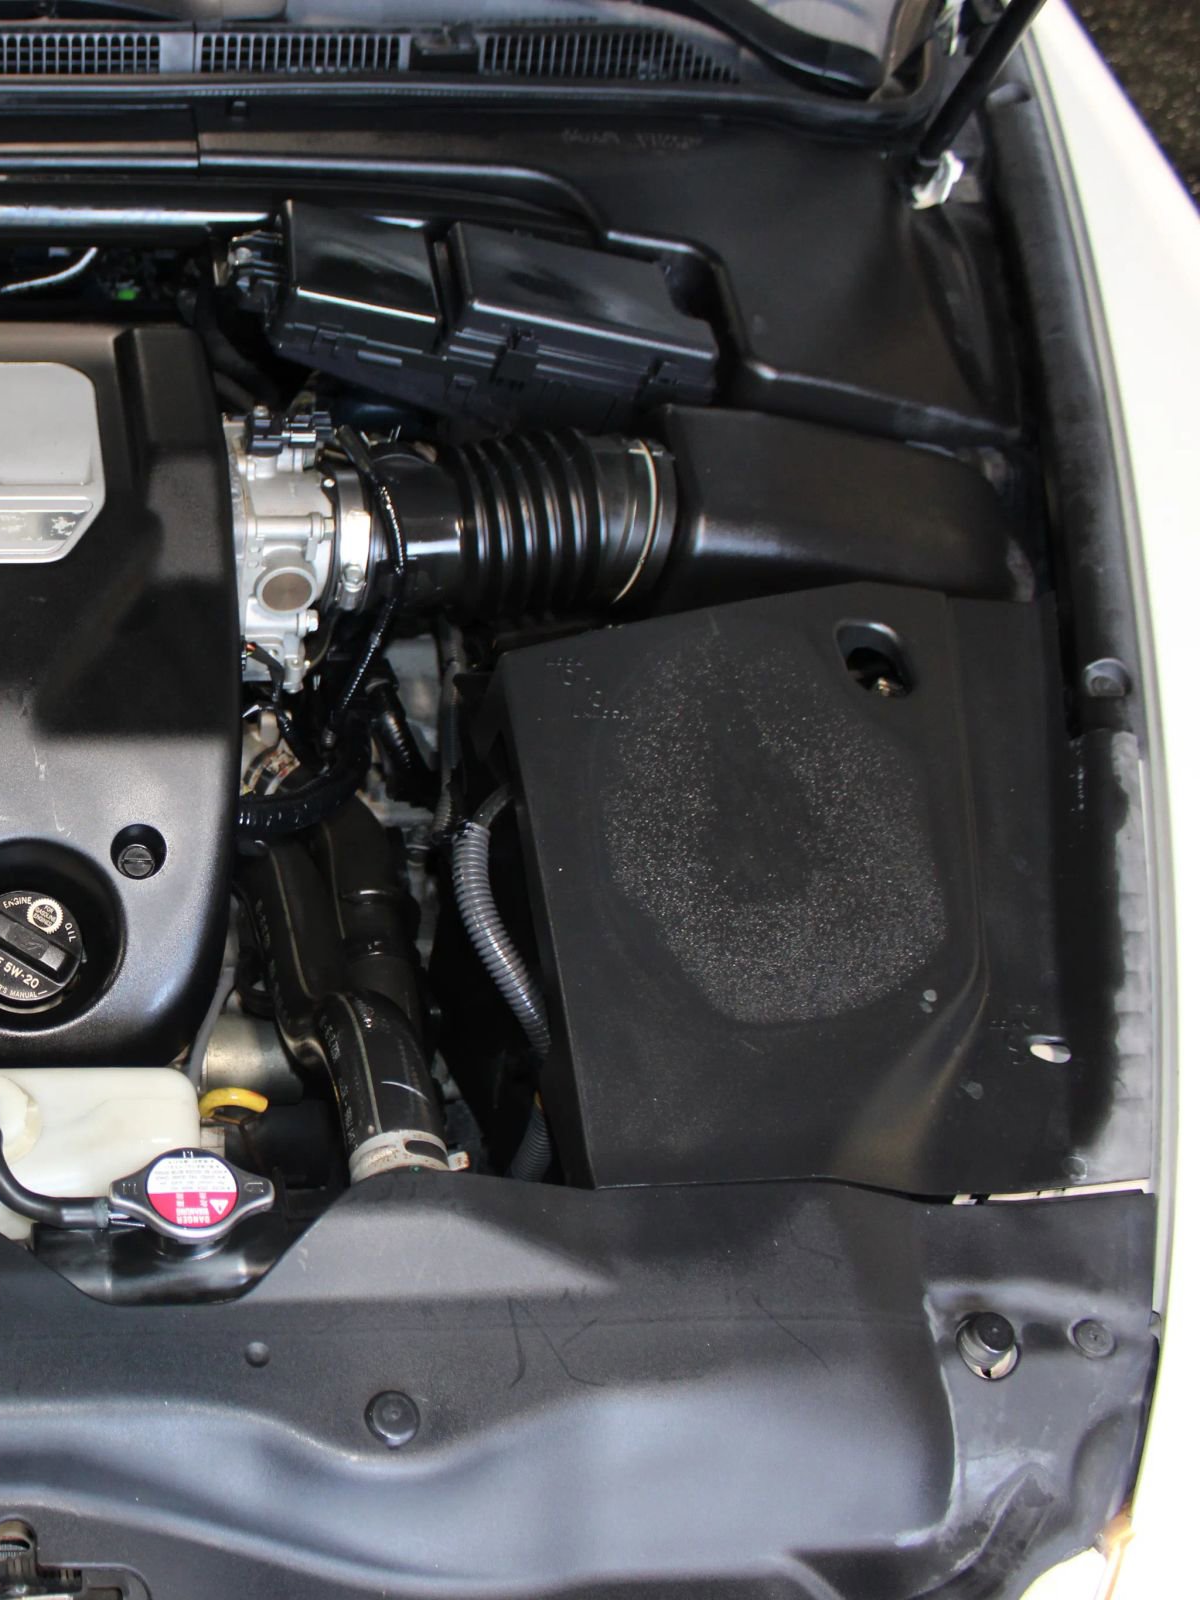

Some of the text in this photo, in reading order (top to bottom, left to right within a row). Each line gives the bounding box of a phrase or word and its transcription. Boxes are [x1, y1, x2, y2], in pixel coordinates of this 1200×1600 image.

[2, 896, 77, 943] ENGINE OIL
[3, 961, 40, 989] 5W-20
[9, 990, 38, 1000] MANUAL
[175, 1215, 211, 1225] DANGER
